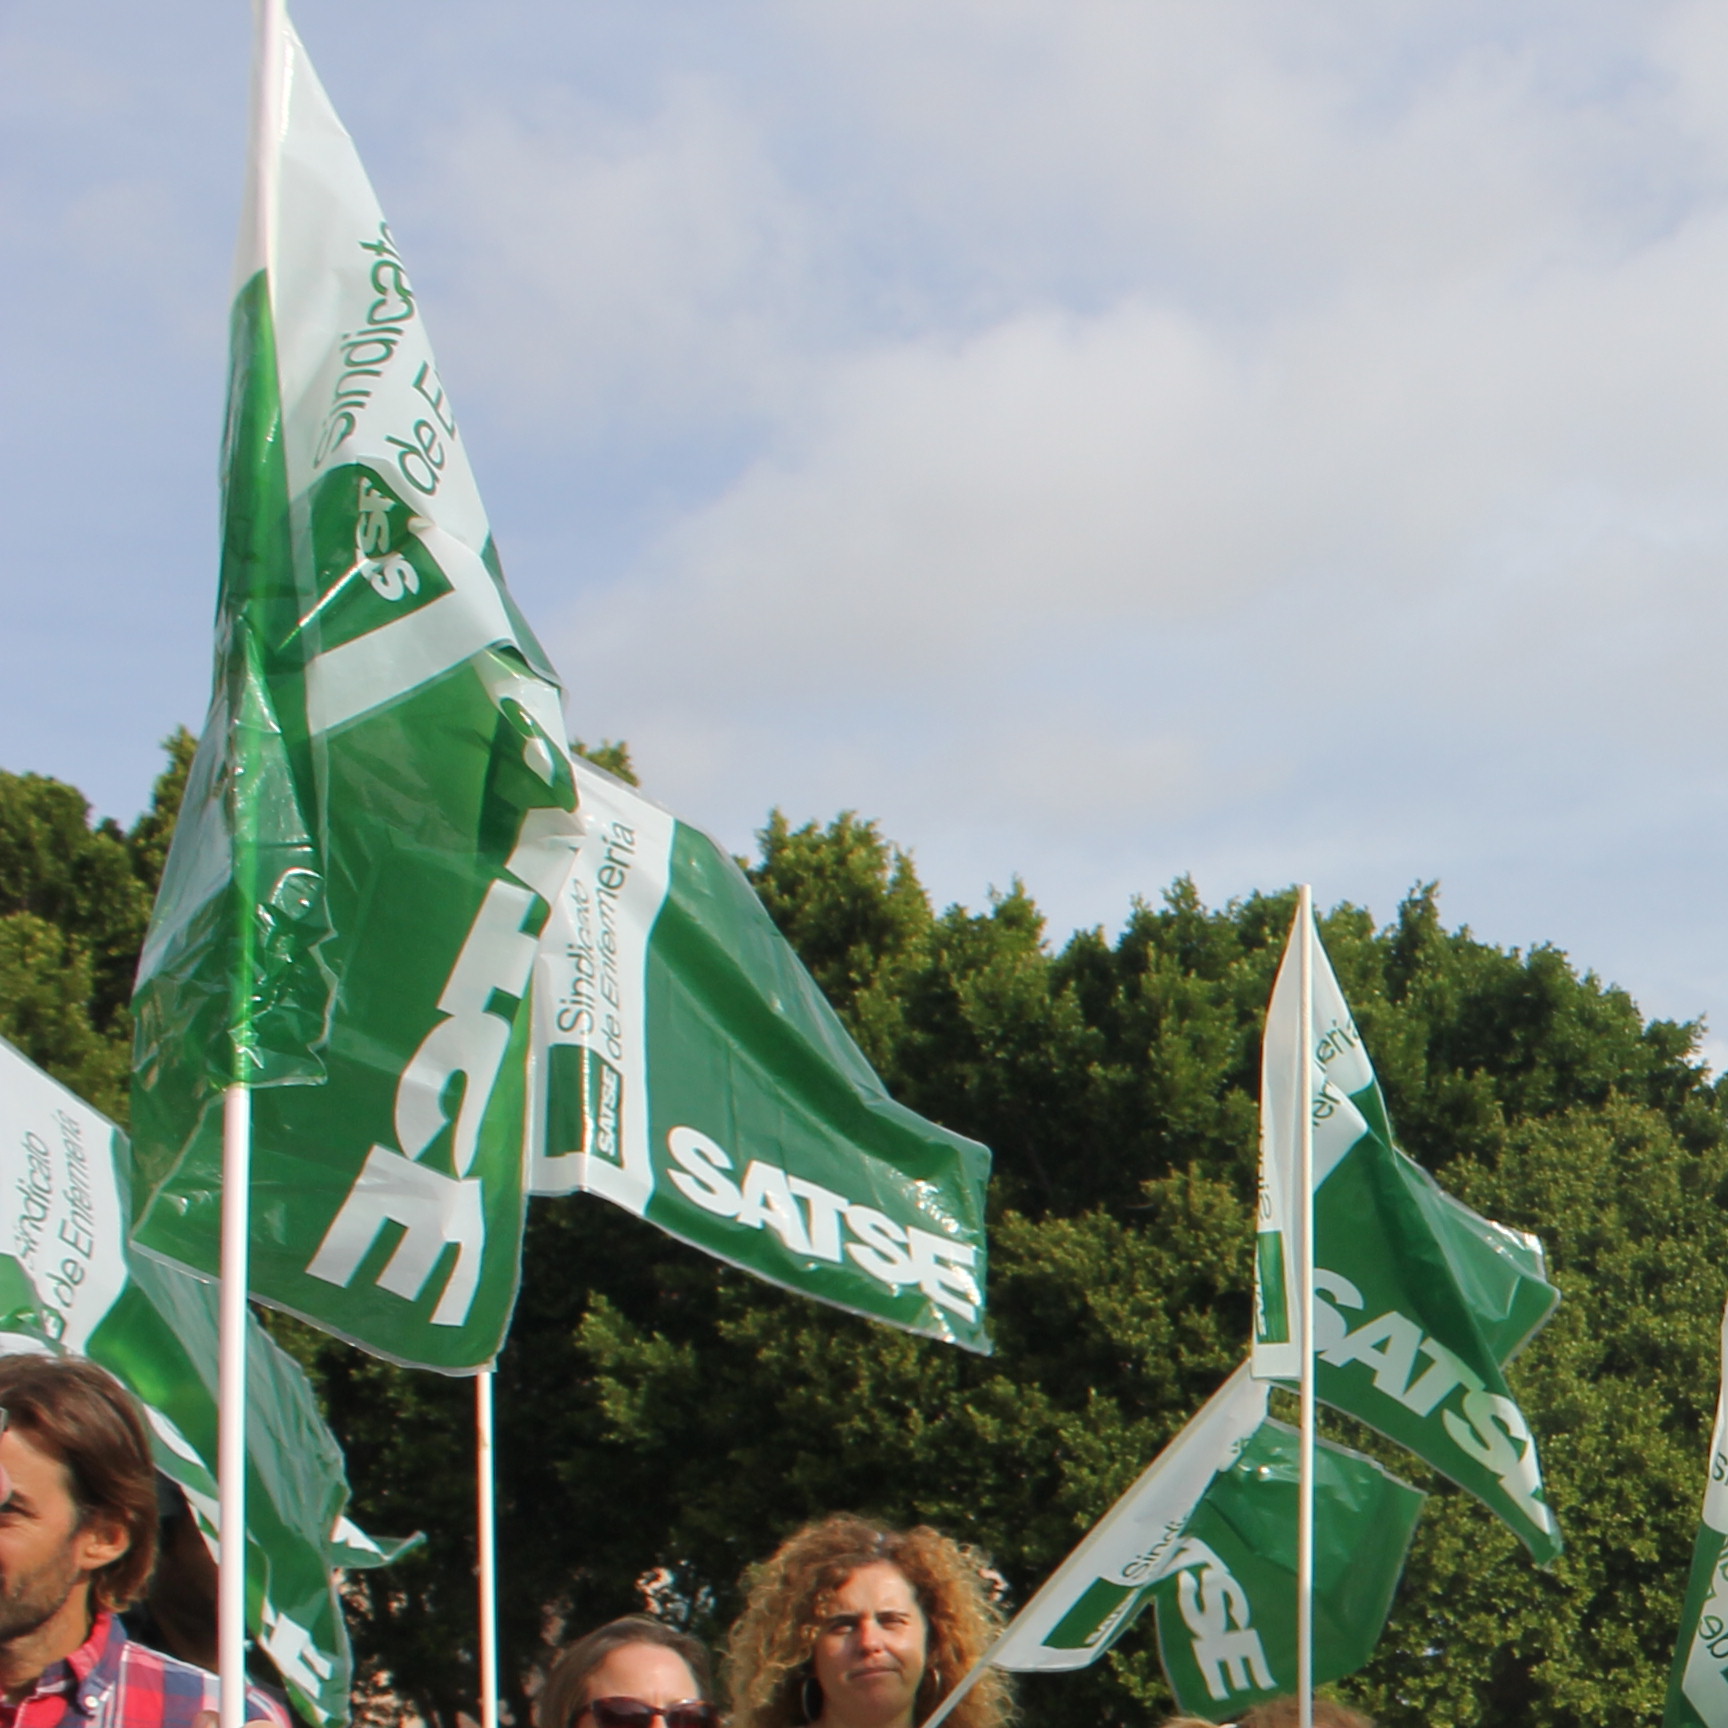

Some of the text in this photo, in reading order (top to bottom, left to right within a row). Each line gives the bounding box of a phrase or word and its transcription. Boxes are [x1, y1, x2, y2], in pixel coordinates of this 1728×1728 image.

[385, 418, 445, 496] de
[600, 1013, 622, 1061] de
[12, 1130, 53, 1262] indicato
[667, 1125, 978, 1324] SATSE
[46, 1258, 86, 1309] de
